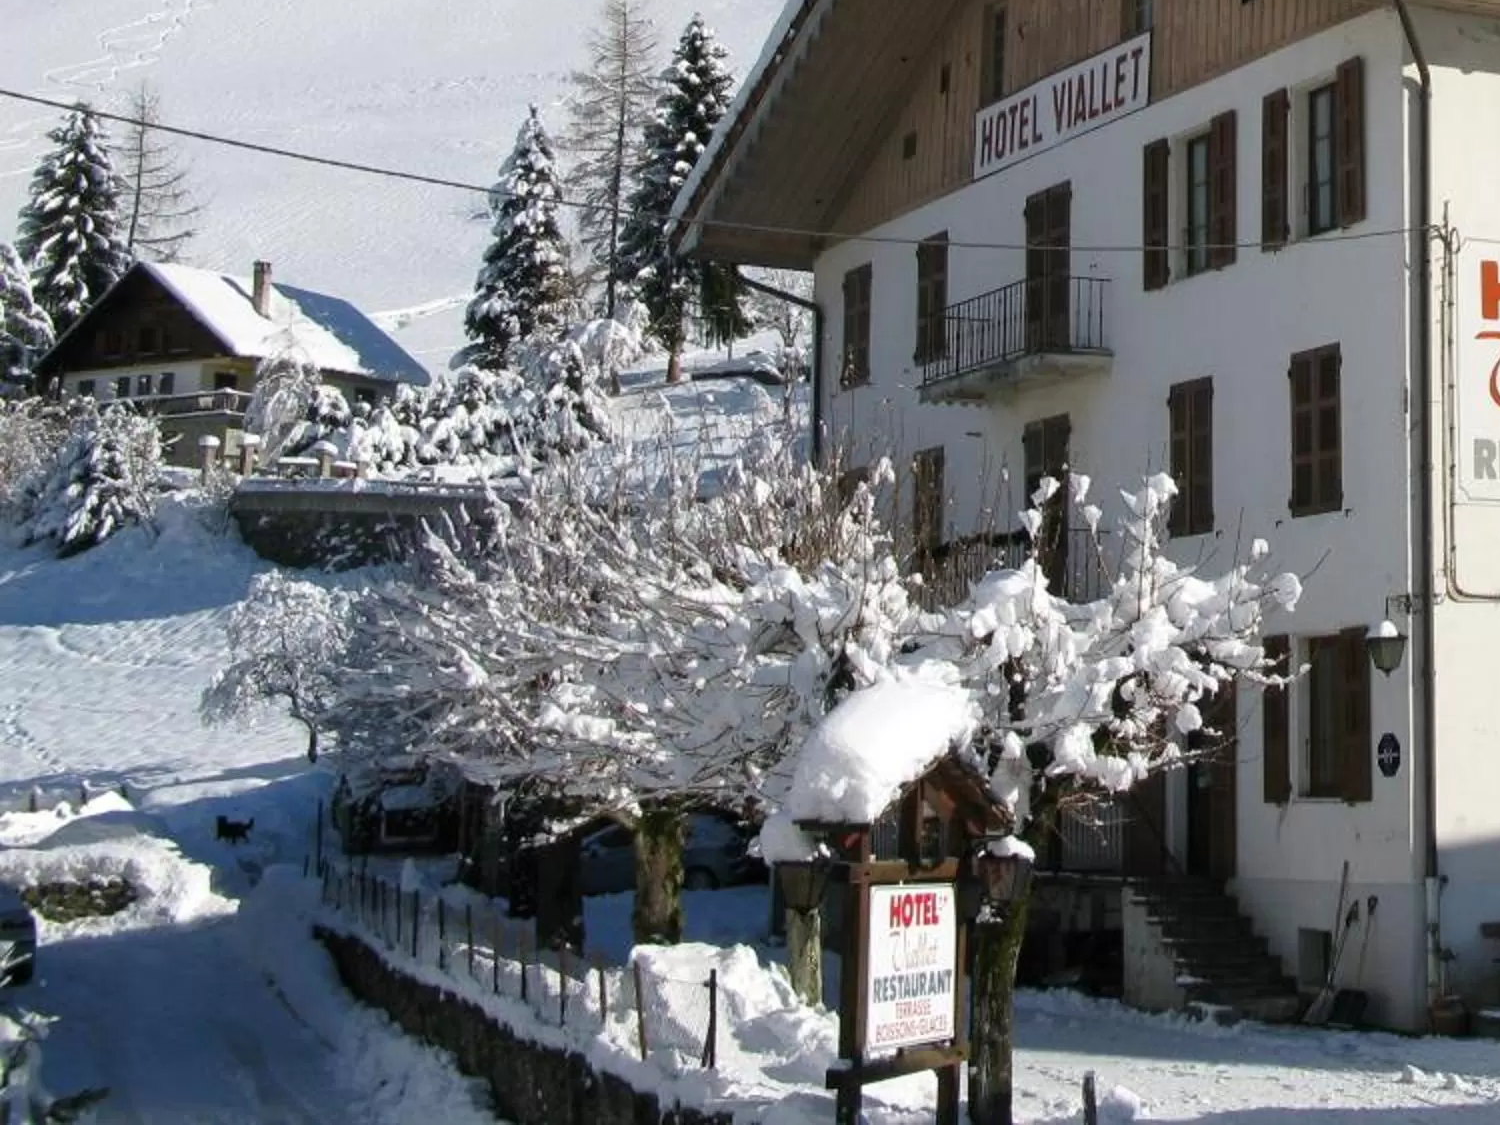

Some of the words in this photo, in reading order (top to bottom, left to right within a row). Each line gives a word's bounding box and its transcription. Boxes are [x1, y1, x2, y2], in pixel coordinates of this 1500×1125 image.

[980, 95, 1043, 167] HOTEL
[1053, 46, 1143, 135] VIALLET
[889, 893, 940, 928] HOTEL
[873, 968, 953, 1004] RESTAURANT
